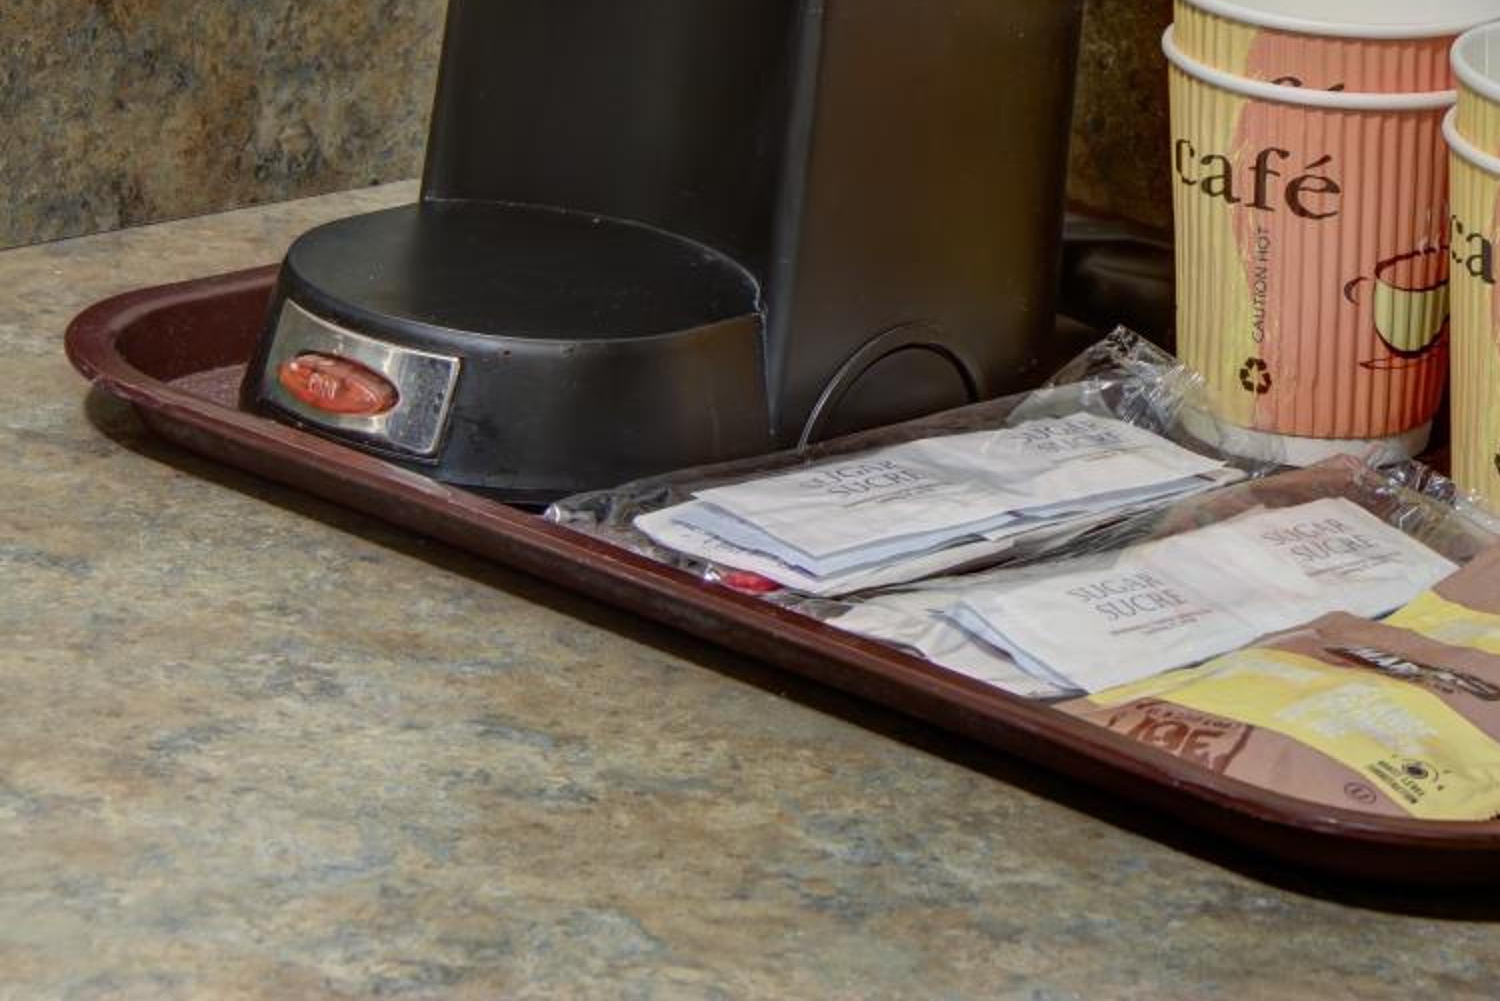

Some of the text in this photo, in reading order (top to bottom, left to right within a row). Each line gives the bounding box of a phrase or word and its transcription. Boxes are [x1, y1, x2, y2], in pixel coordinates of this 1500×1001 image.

[1176, 139, 1340, 220] café
[1251, 227, 1271, 344] CAUTION HOT
[1262, 517, 1348, 546] SUGAR
[1066, 570, 1164, 602] SUGAR
[1095, 586, 1187, 621] SUCRE
